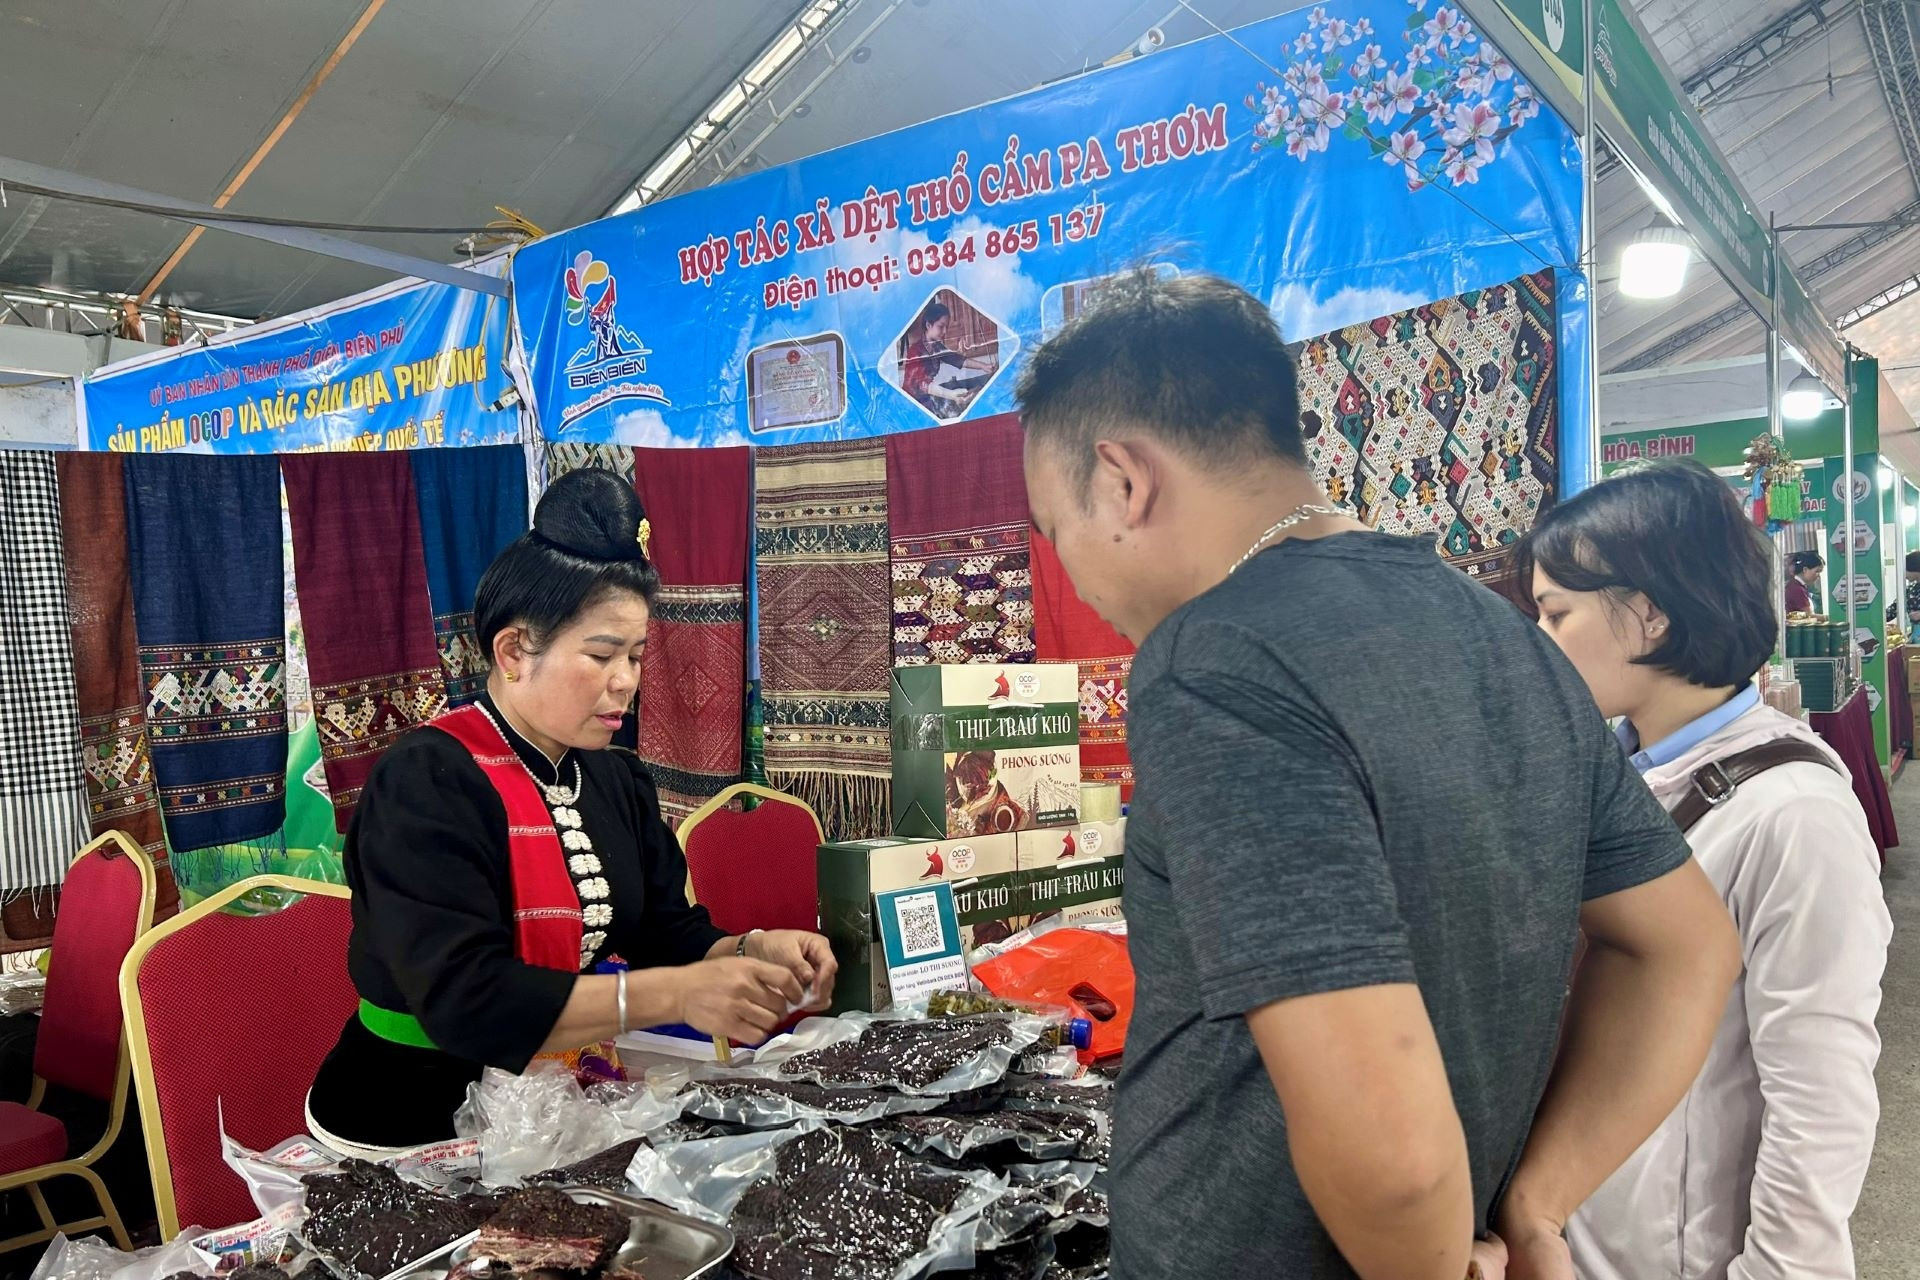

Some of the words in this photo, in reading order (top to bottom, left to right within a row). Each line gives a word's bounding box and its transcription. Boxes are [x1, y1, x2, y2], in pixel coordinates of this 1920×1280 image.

[680, 236, 728, 285] HỢP
[736, 217, 788, 267] TÁC
[796, 200, 835, 251] XÃ
[843, 187, 900, 243] DỆT
[907, 152, 970, 224] THỔ
[980, 136, 1051, 204] CẨM
[1060, 138, 1110, 186] PA
[1117, 105, 1227, 172] THƠM
[765, 275, 817, 309] Điện
[827, 256, 898, 291] thoại:
[907, 237, 975, 276] 0384
[985, 221, 1037, 257] 865
[1050, 204, 1104, 244] 137
[166, 382, 186, 403] BAN
[189, 372, 219, 397] NHÂN
[284, 345, 311, 372] PHỐ
[345, 331, 376, 359] BIÊN
[141, 410, 185, 452] PHẨM
[190, 407, 233, 444] OCOP
[239, 396, 262, 434] VÀ
[261, 388, 299, 433] ĐẶC
[350, 370, 393, 414] ĐỊA
[393, 344, 486, 400] PHƯƠNG
[422, 410, 444, 444] TẾ
[1603, 438, 1640, 462] HÒA
[1647, 434, 1695, 457] BÌNH
[956, 718, 992, 740] THỊT
[997, 714, 1037, 738] TRÂU
[1042, 712, 1071, 735] KHÔ
[1002, 755, 1038, 769] PHONG
[1040, 752, 1071, 767] SƯƠNG
[952, 848, 971, 858] OCOP
[977, 884, 1008, 911] KHÔ
[1029, 877, 1061, 902] THỊT
[1065, 869, 1098, 894] TRÂU
